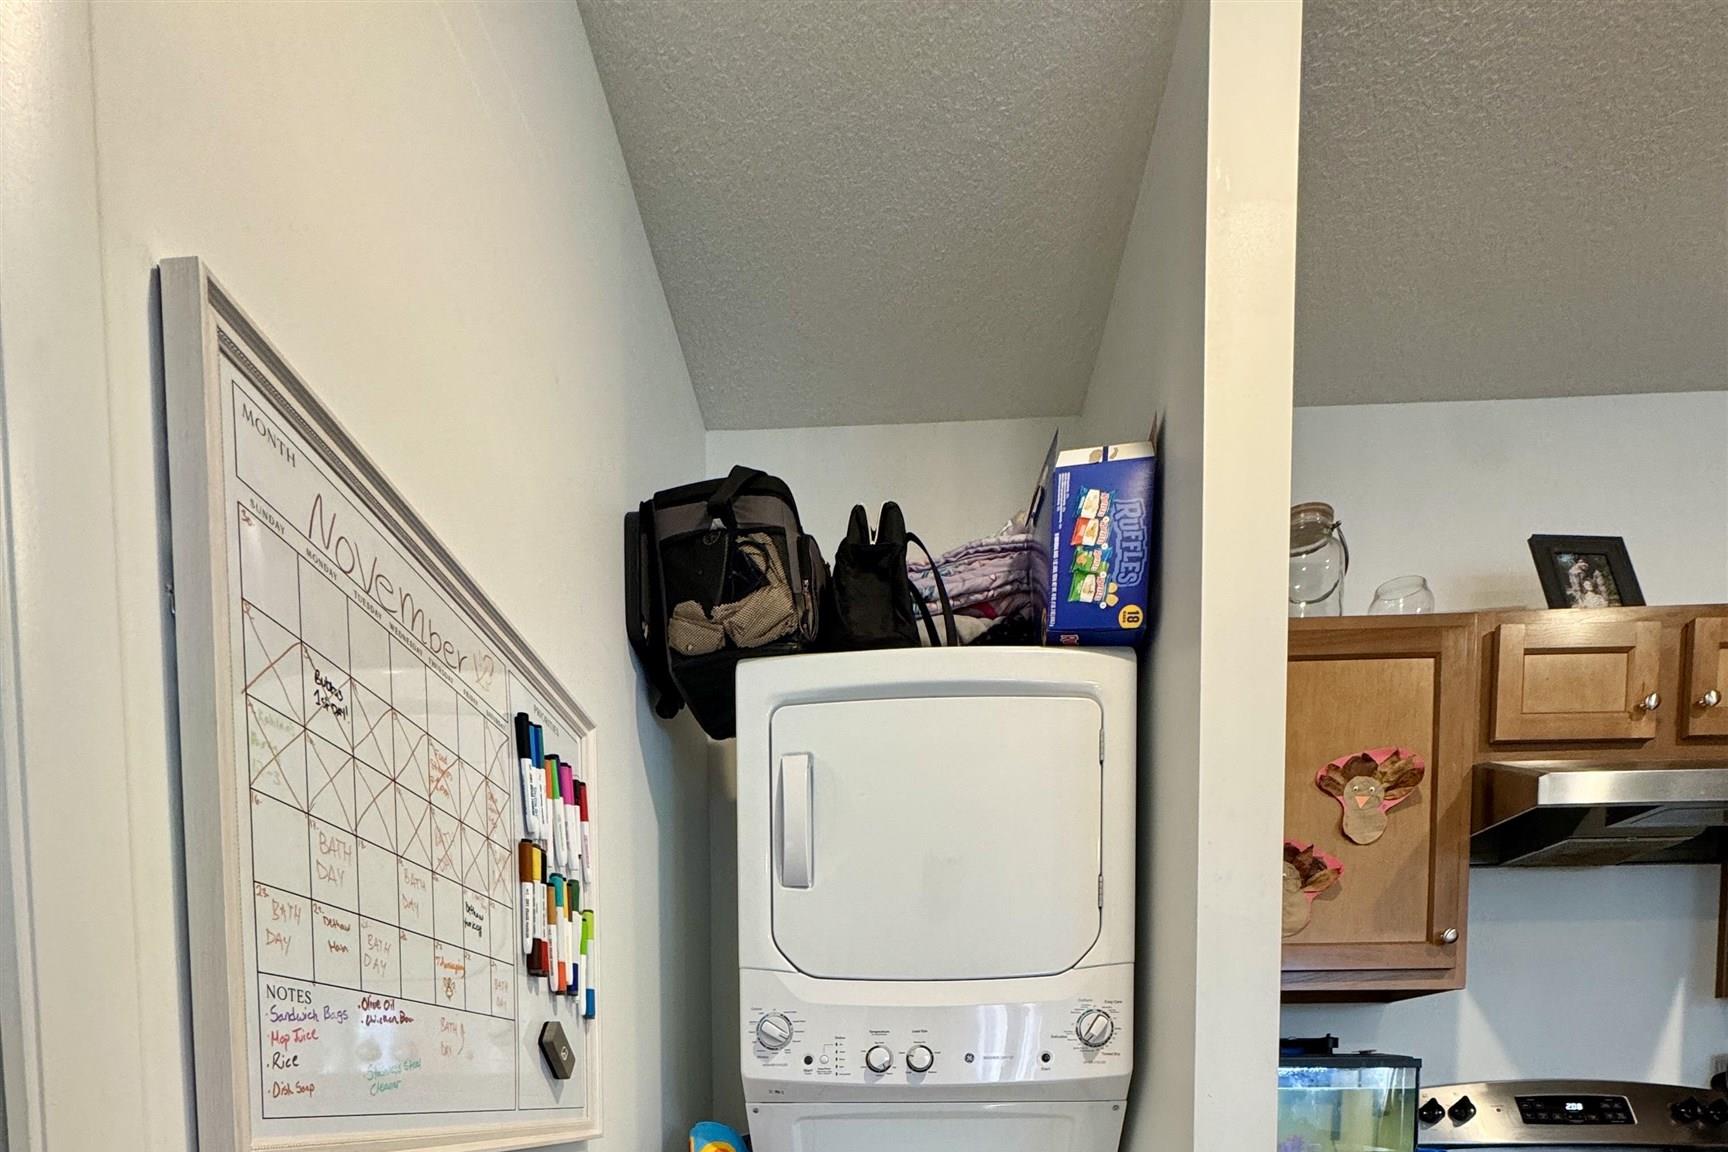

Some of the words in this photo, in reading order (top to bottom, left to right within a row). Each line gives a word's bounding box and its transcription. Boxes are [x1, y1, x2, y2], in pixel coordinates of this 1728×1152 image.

[242, 403, 296, 468] MONTH
[250, 498, 285, 535] SUNDAY
[1113, 500, 1145, 587] RUFFLES
[306, 547, 337, 581] MONDAY
[308, 493, 468, 673] November
[353, 589, 382, 620] TUESDAY
[1126, 610, 1140, 624] 18
[319, 831, 352, 861] BATH
[316, 859, 345, 887] DAY
[272, 898, 302, 926] BATH
[265, 928, 292, 957] DAY
[367, 934, 392, 954] BATH
[363, 953, 388, 978] DAY
[266, 983, 312, 1005] NOTES
[383, 998, 395, 1011] Oil
[269, 1004, 319, 1023] Sandwich
[323, 1005, 349, 1024] Bags
[270, 1030, 290, 1051] Mop
[272, 1051, 300, 1070] Rice
[272, 1081, 294, 1098] Dish
[295, 1082, 316, 1098] Soap
